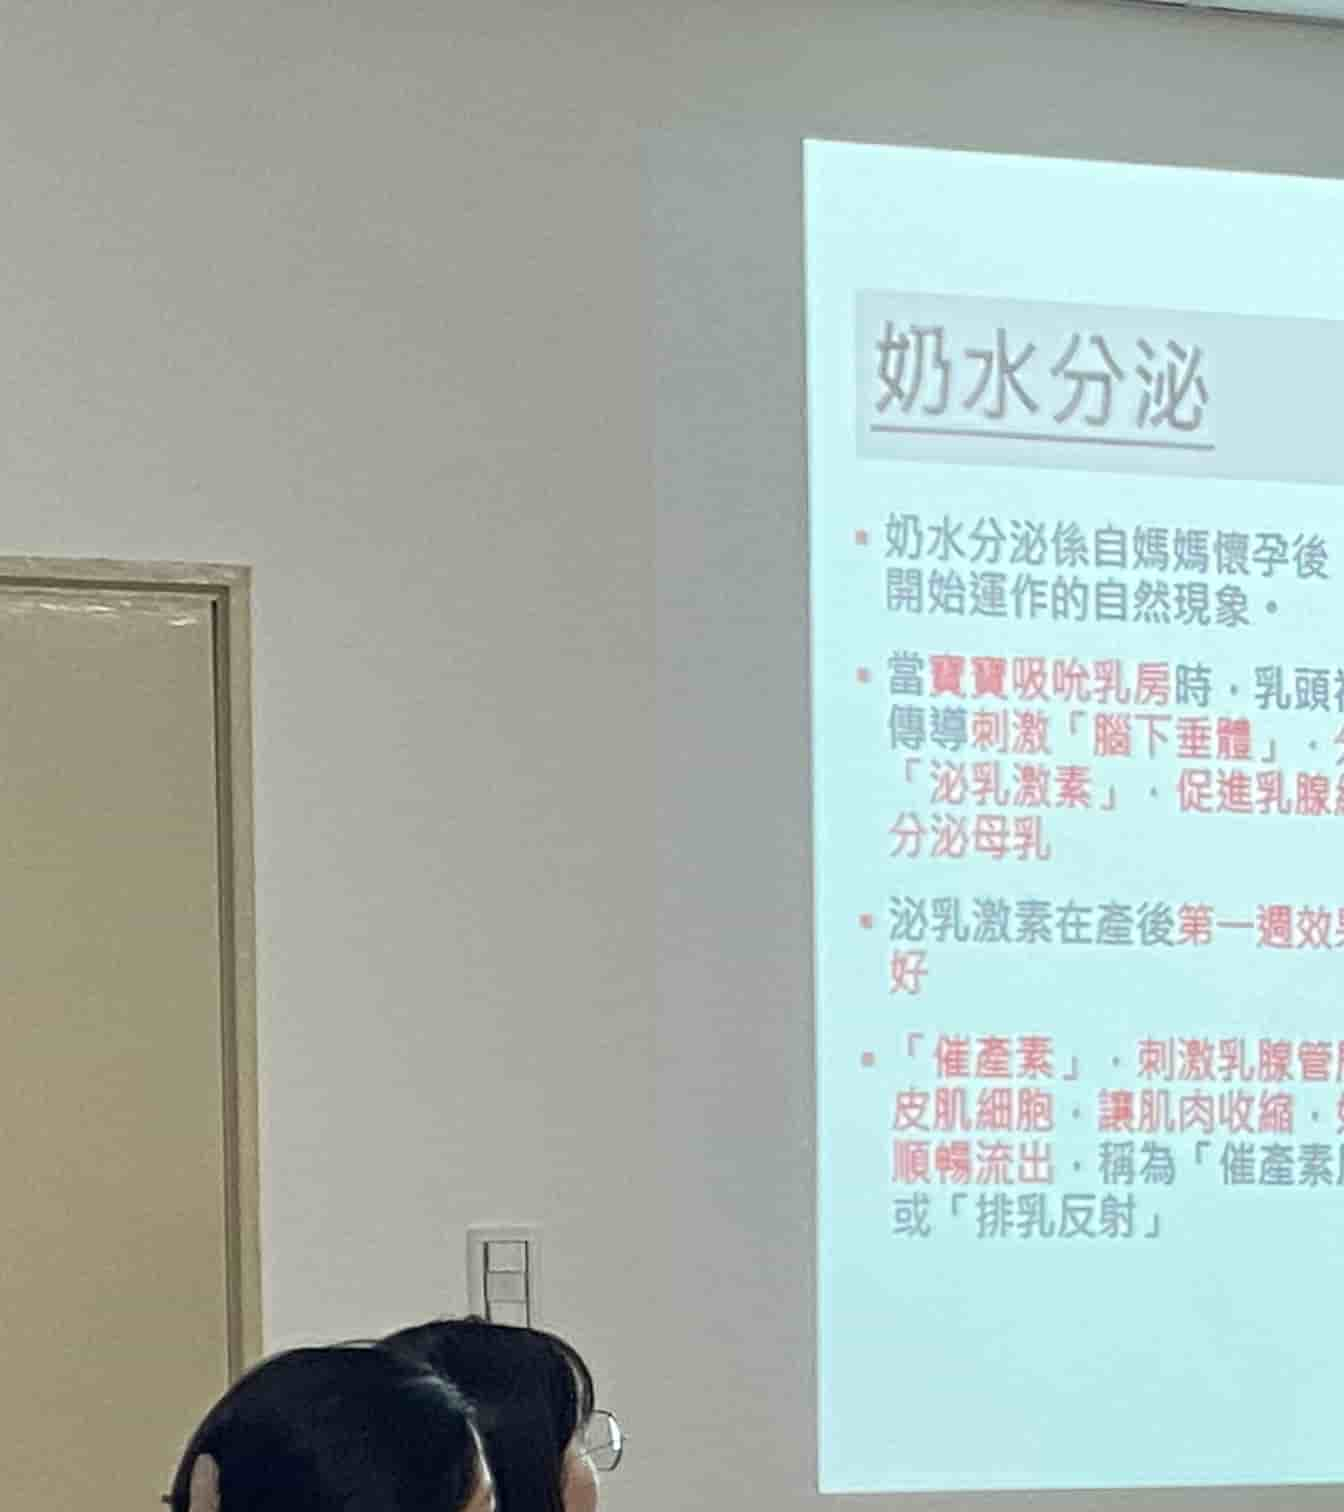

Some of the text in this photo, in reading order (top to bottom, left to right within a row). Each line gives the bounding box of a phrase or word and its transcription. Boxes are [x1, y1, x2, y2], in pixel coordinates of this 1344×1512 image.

[876, 321, 1208, 432] 奶水分泌
[888, 814, 1051, 862] 分泌母乳
[889, 950, 928, 996] 好
